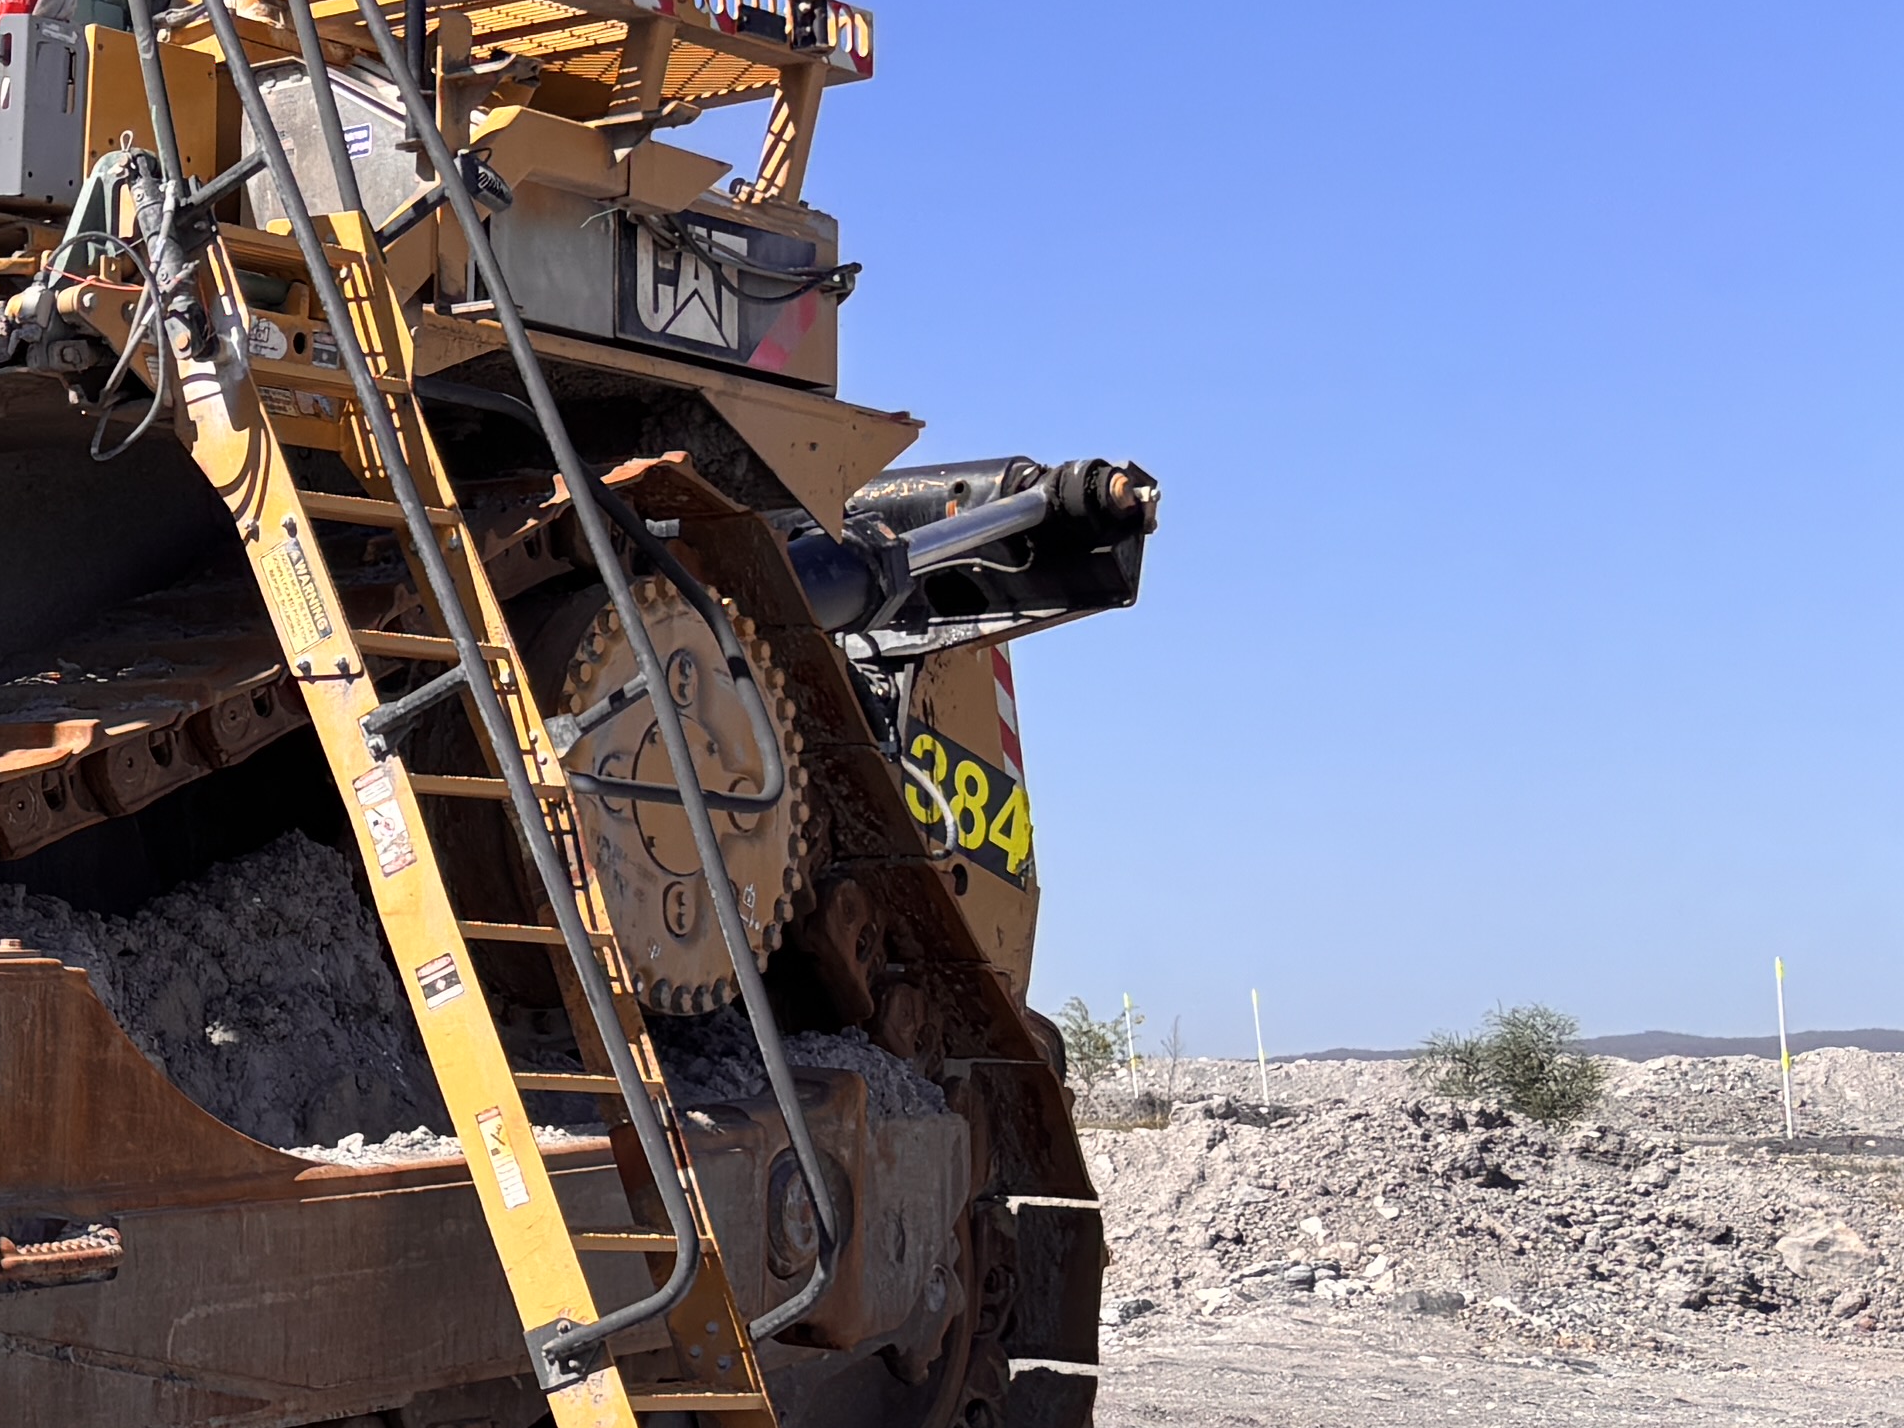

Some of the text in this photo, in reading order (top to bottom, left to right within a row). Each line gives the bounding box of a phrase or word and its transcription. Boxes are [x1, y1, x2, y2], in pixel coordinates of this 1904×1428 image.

[637, 224, 747, 350] CAT
[294, 558, 328, 631] WARNING
[904, 733, 1033, 874] 384
